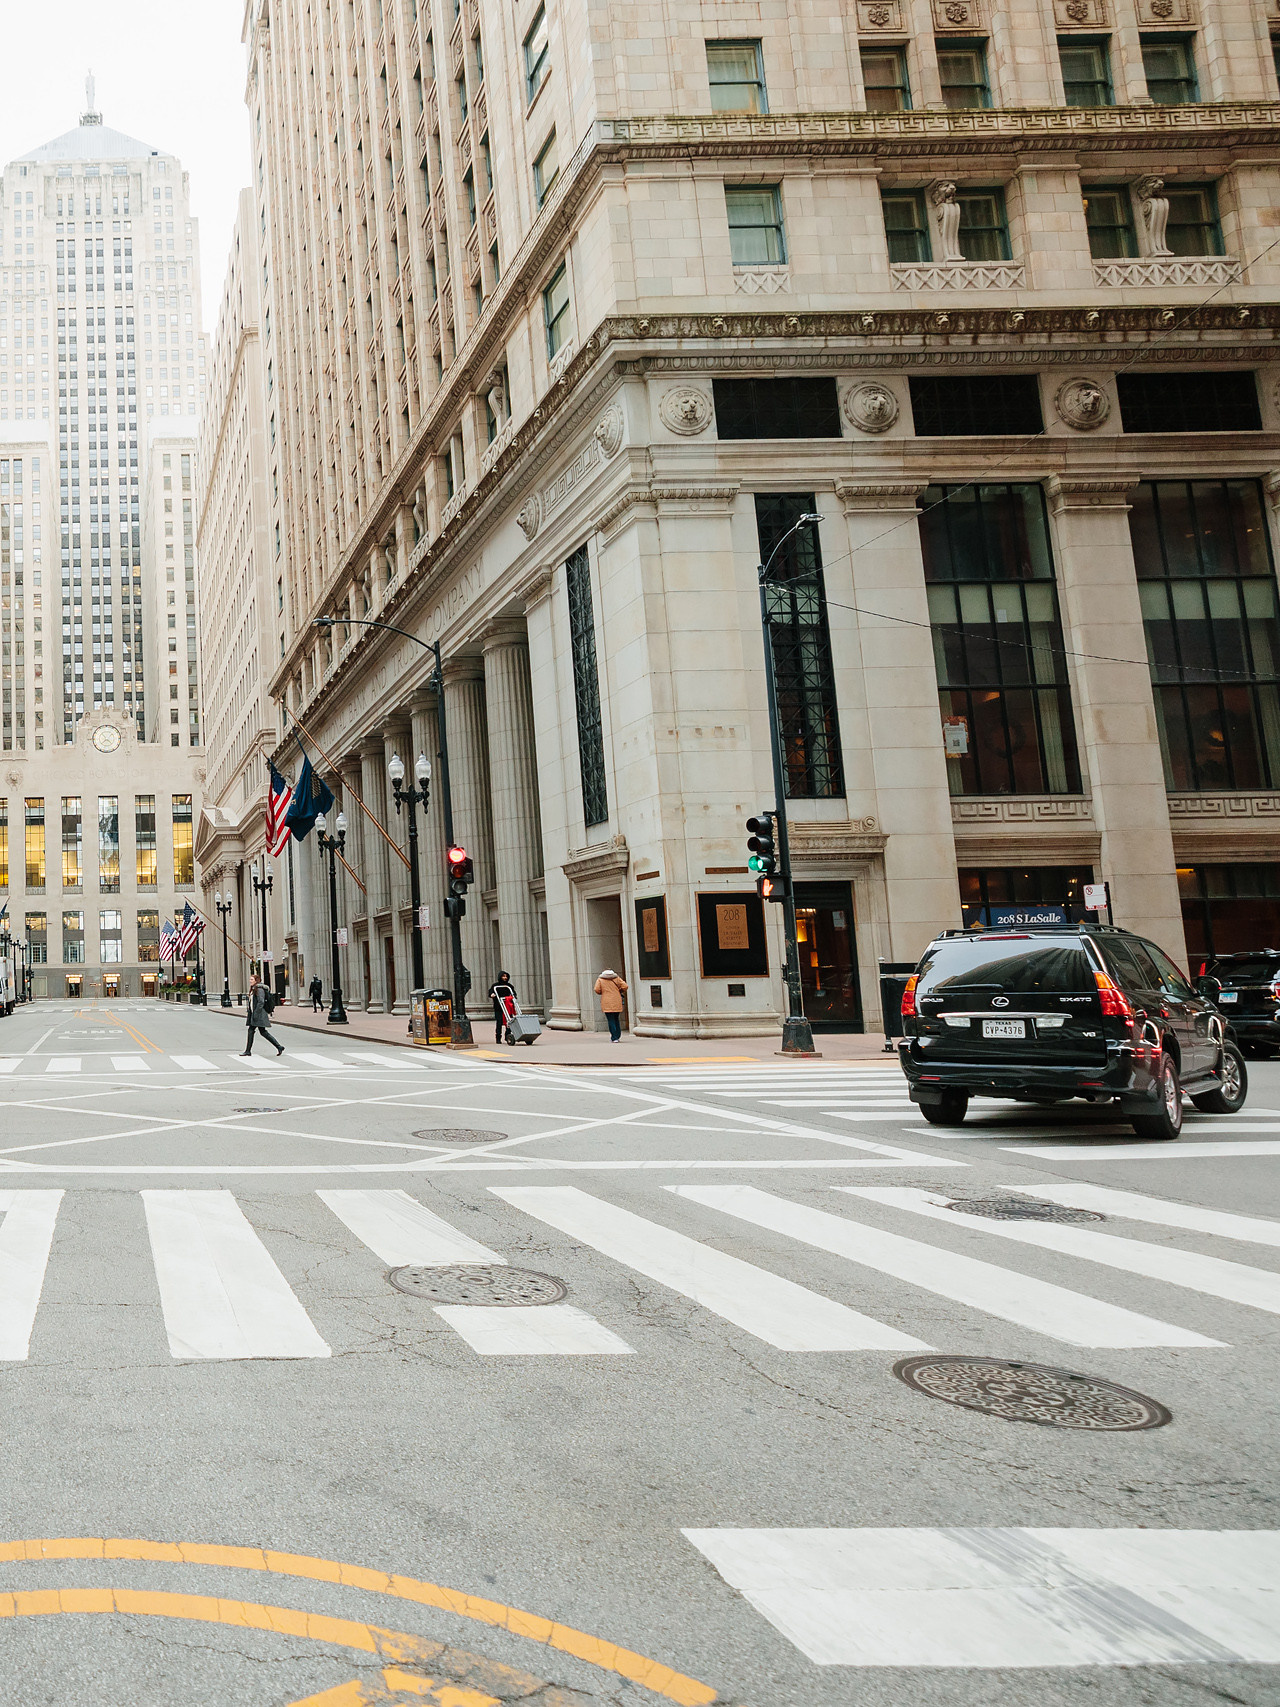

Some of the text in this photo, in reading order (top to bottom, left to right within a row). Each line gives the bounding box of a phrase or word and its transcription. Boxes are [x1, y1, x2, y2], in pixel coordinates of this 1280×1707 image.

[425, 557, 482, 641] COMPANY
[89, 768, 126, 779] BOARD
[723, 909, 740, 921] 208
[997, 912, 1061, 924] 208 S LaSalle
